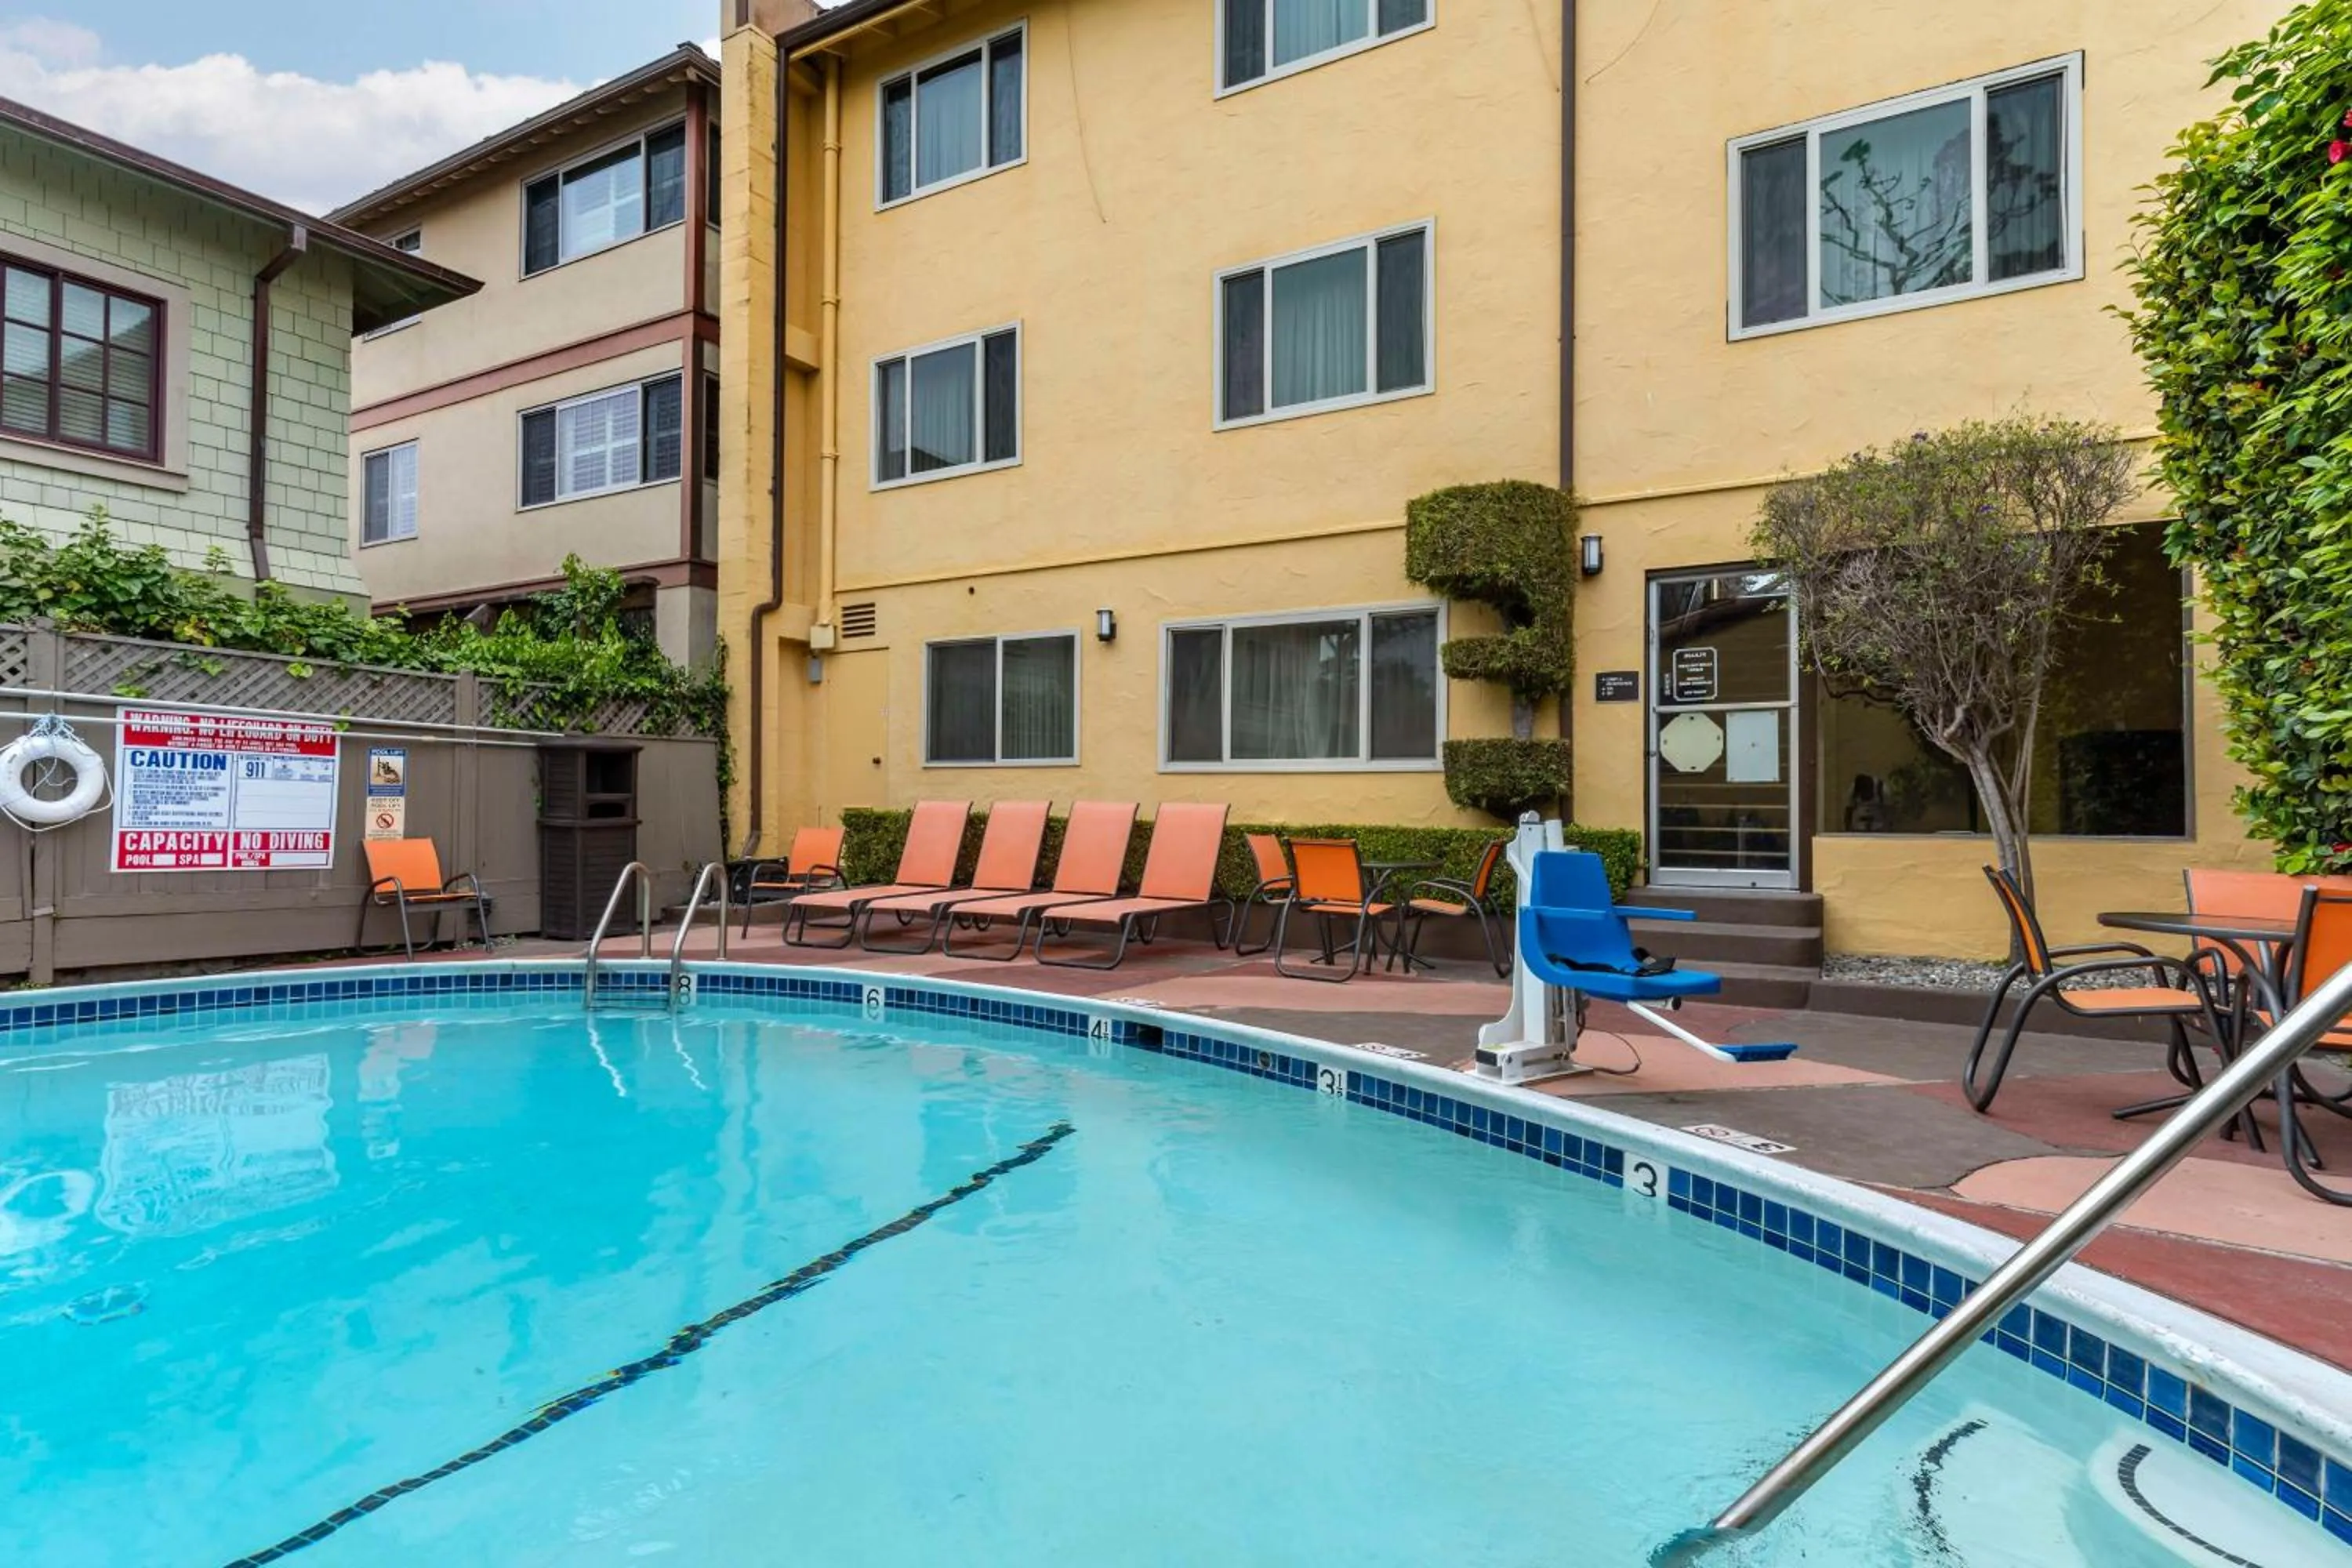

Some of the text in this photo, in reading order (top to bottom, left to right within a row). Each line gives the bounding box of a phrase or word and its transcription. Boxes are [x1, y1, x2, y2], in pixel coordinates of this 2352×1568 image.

[130, 750, 227, 771] CAUTION
[245, 761, 266, 778] 911
[124, 832, 227, 851] CAPACITY
[239, 833, 324, 850] NO DIVING
[125, 853, 200, 866] POOL SPA
[1634, 1162, 1657, 1197] 3
